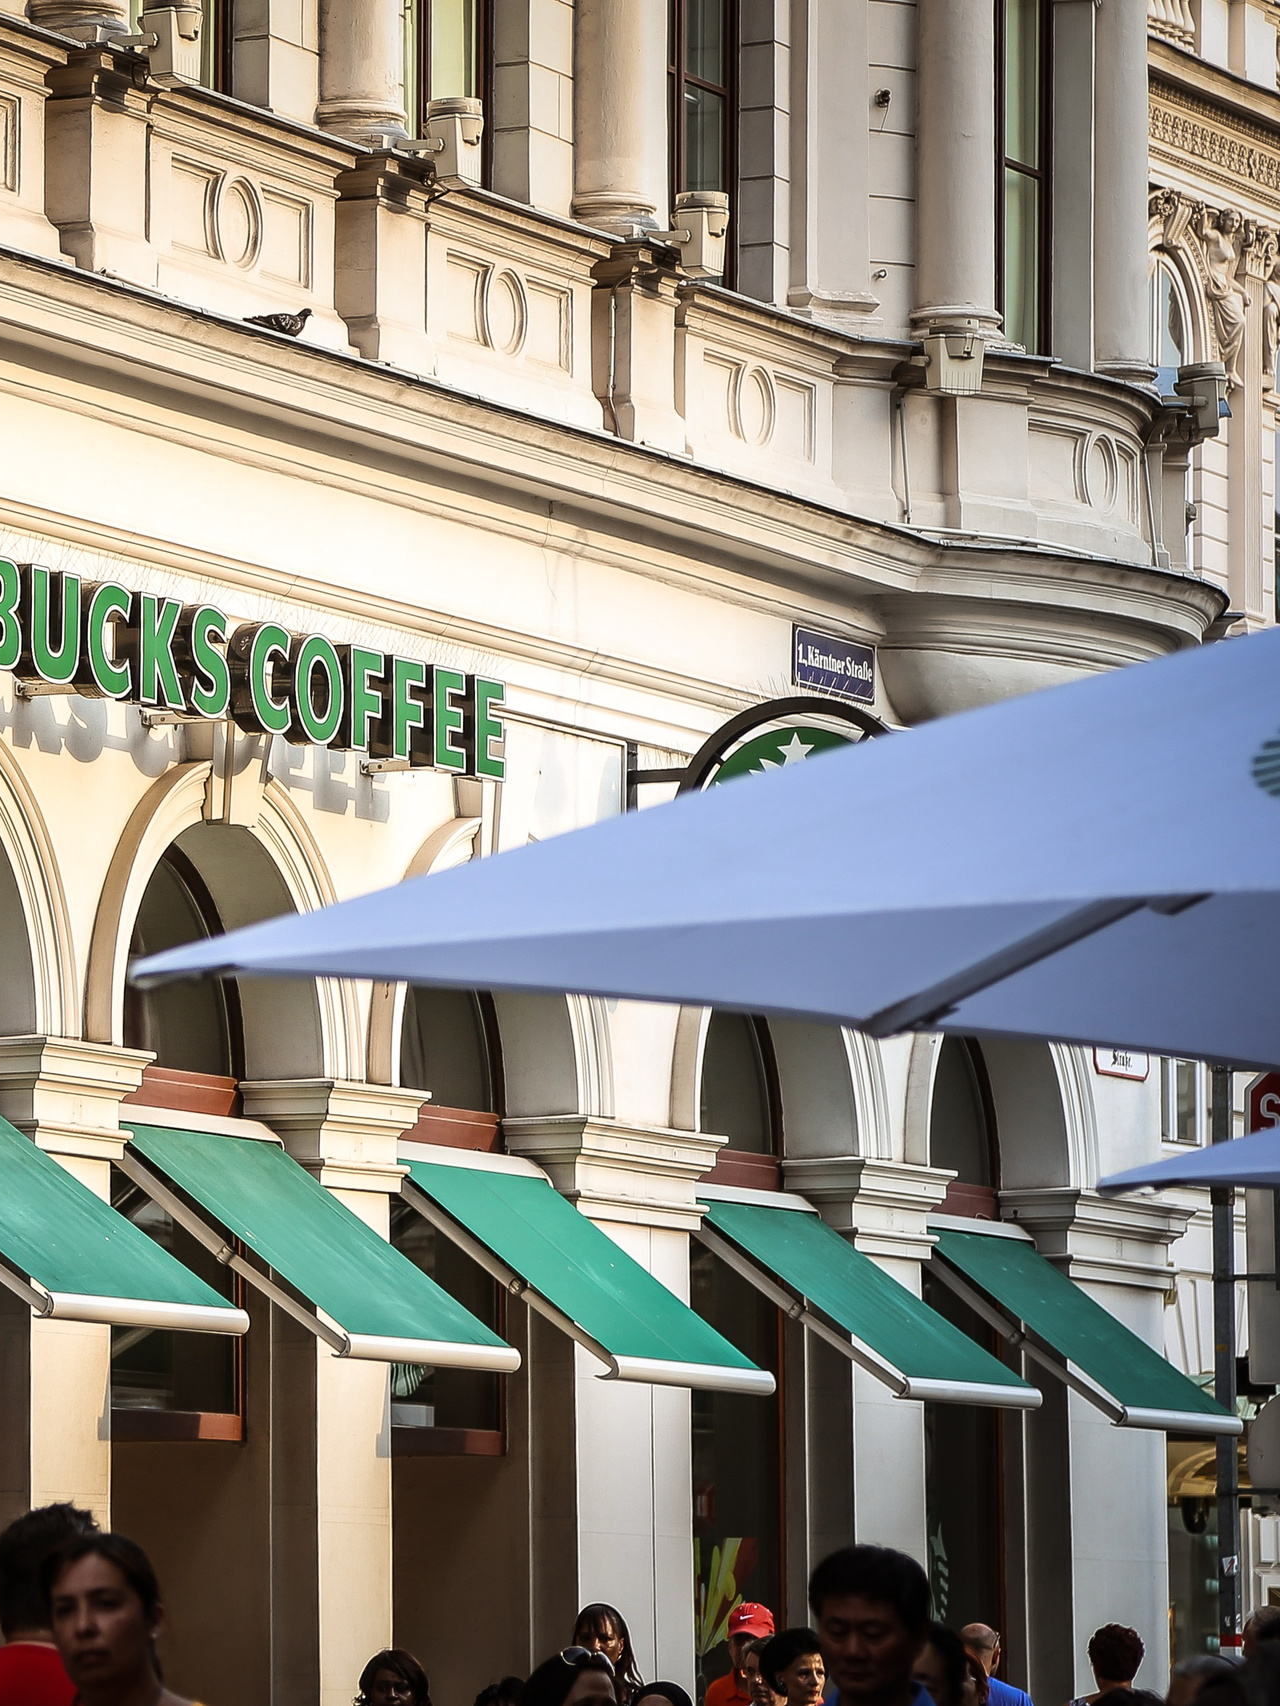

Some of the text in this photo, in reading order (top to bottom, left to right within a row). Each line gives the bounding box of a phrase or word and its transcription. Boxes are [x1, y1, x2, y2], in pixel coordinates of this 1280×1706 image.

[248, 621, 508, 782] COFFEE
[807, 645, 845, 675] Kärntner
[846, 656, 873, 682] Straße
